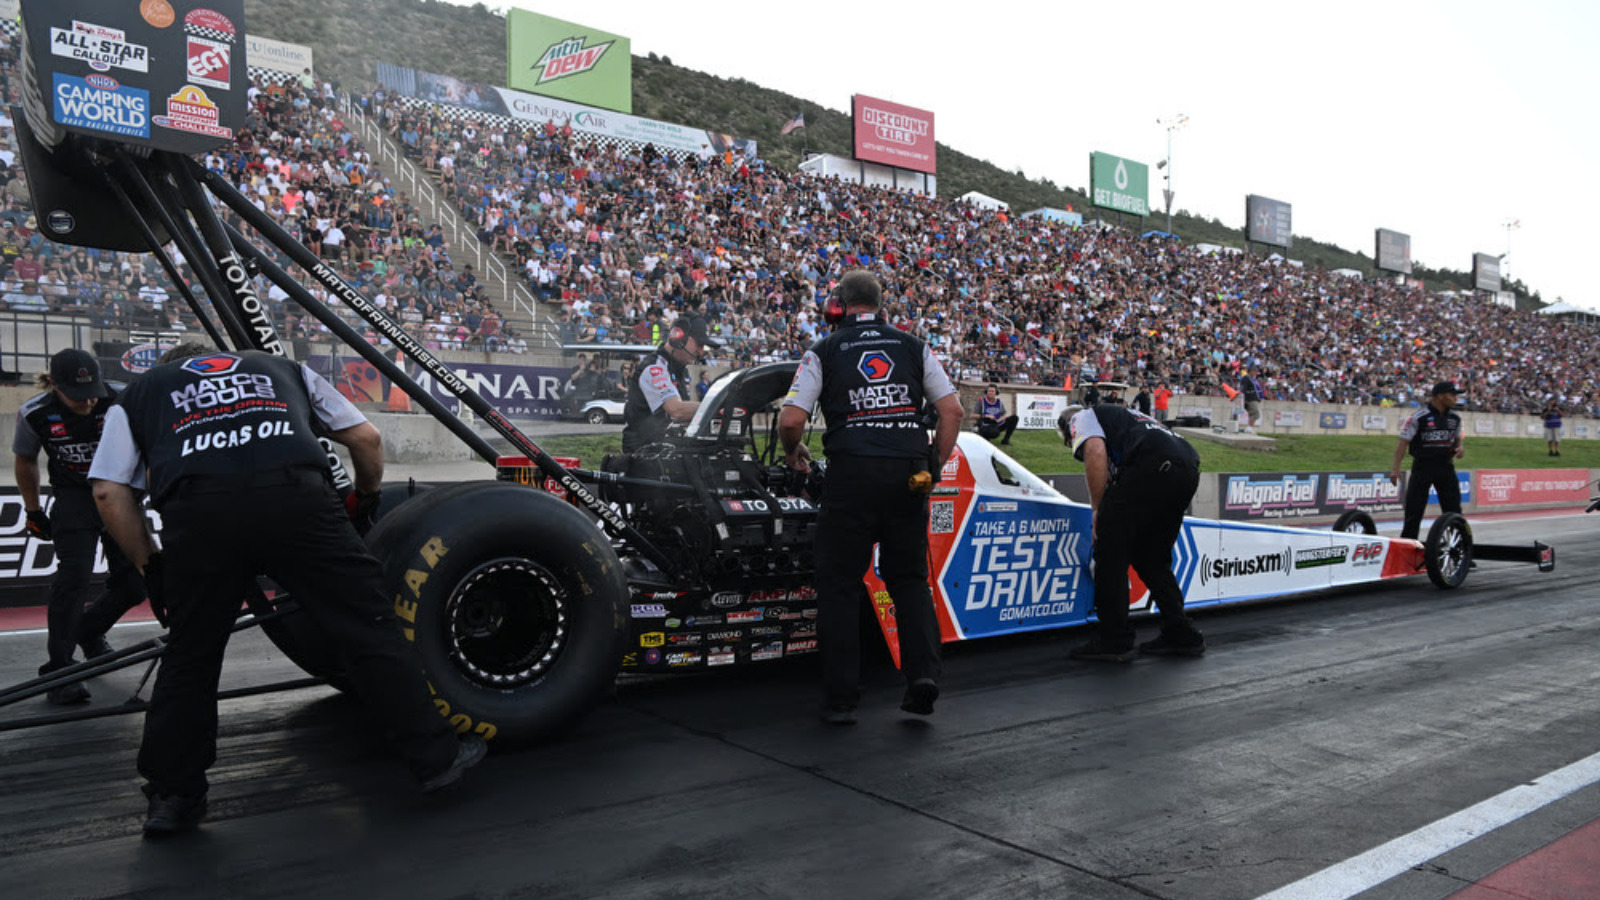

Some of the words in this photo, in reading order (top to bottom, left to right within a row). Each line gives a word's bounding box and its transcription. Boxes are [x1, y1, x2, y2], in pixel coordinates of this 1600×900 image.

[55, 31, 89, 49] ALL
[100, 40, 145, 60] STAR
[73, 48, 123, 65] CALLOUT
[57, 83, 145, 112] CAMPING
[170, 102, 216, 118] MISSION
[58, 97, 146, 128] WORLD
[863, 107, 929, 136] DISCOUNT
[173, 120, 228, 137] CHALLENGE
[880, 126, 913, 144] TIRE
[1094, 186, 1110, 205] GET
[1112, 191, 1147, 214] BIOFUEL
[312, 263, 468, 395] MATCOFRANCHISE.COM
[170, 372, 273, 405] MATCO
[174, 384, 277, 414] TOOLS
[848, 383, 909, 401] MATCO
[850, 394, 912, 411] TOOLS
[172, 412, 202, 430] LIVE
[205, 406, 232, 415] THE
[234, 399, 288, 411] DREAM
[181, 424, 253, 458] LUCAS
[257, 420, 295, 440] OIL
[560, 474, 627, 531] GOODYEAR
[742, 498, 814, 512] TOOTA
[1228, 476, 1316, 511] MagnaFuel
[1328, 476, 1400, 506] MagnaFuel
[975, 520, 1004, 536] TAKE
[1007, 522, 1015, 535] A
[1018, 521, 1028, 534] 6
[1029, 518, 1070, 534] MONTH
[970, 534, 1056, 573] TEST
[1351, 542, 1383, 562] FVP
[965, 567, 1081, 610] DRIVE!
[999, 601, 1075, 621] GOMATCO.COM
[707, 630, 742, 640] DIAMOND
[787, 640, 818, 650] MANLEY
